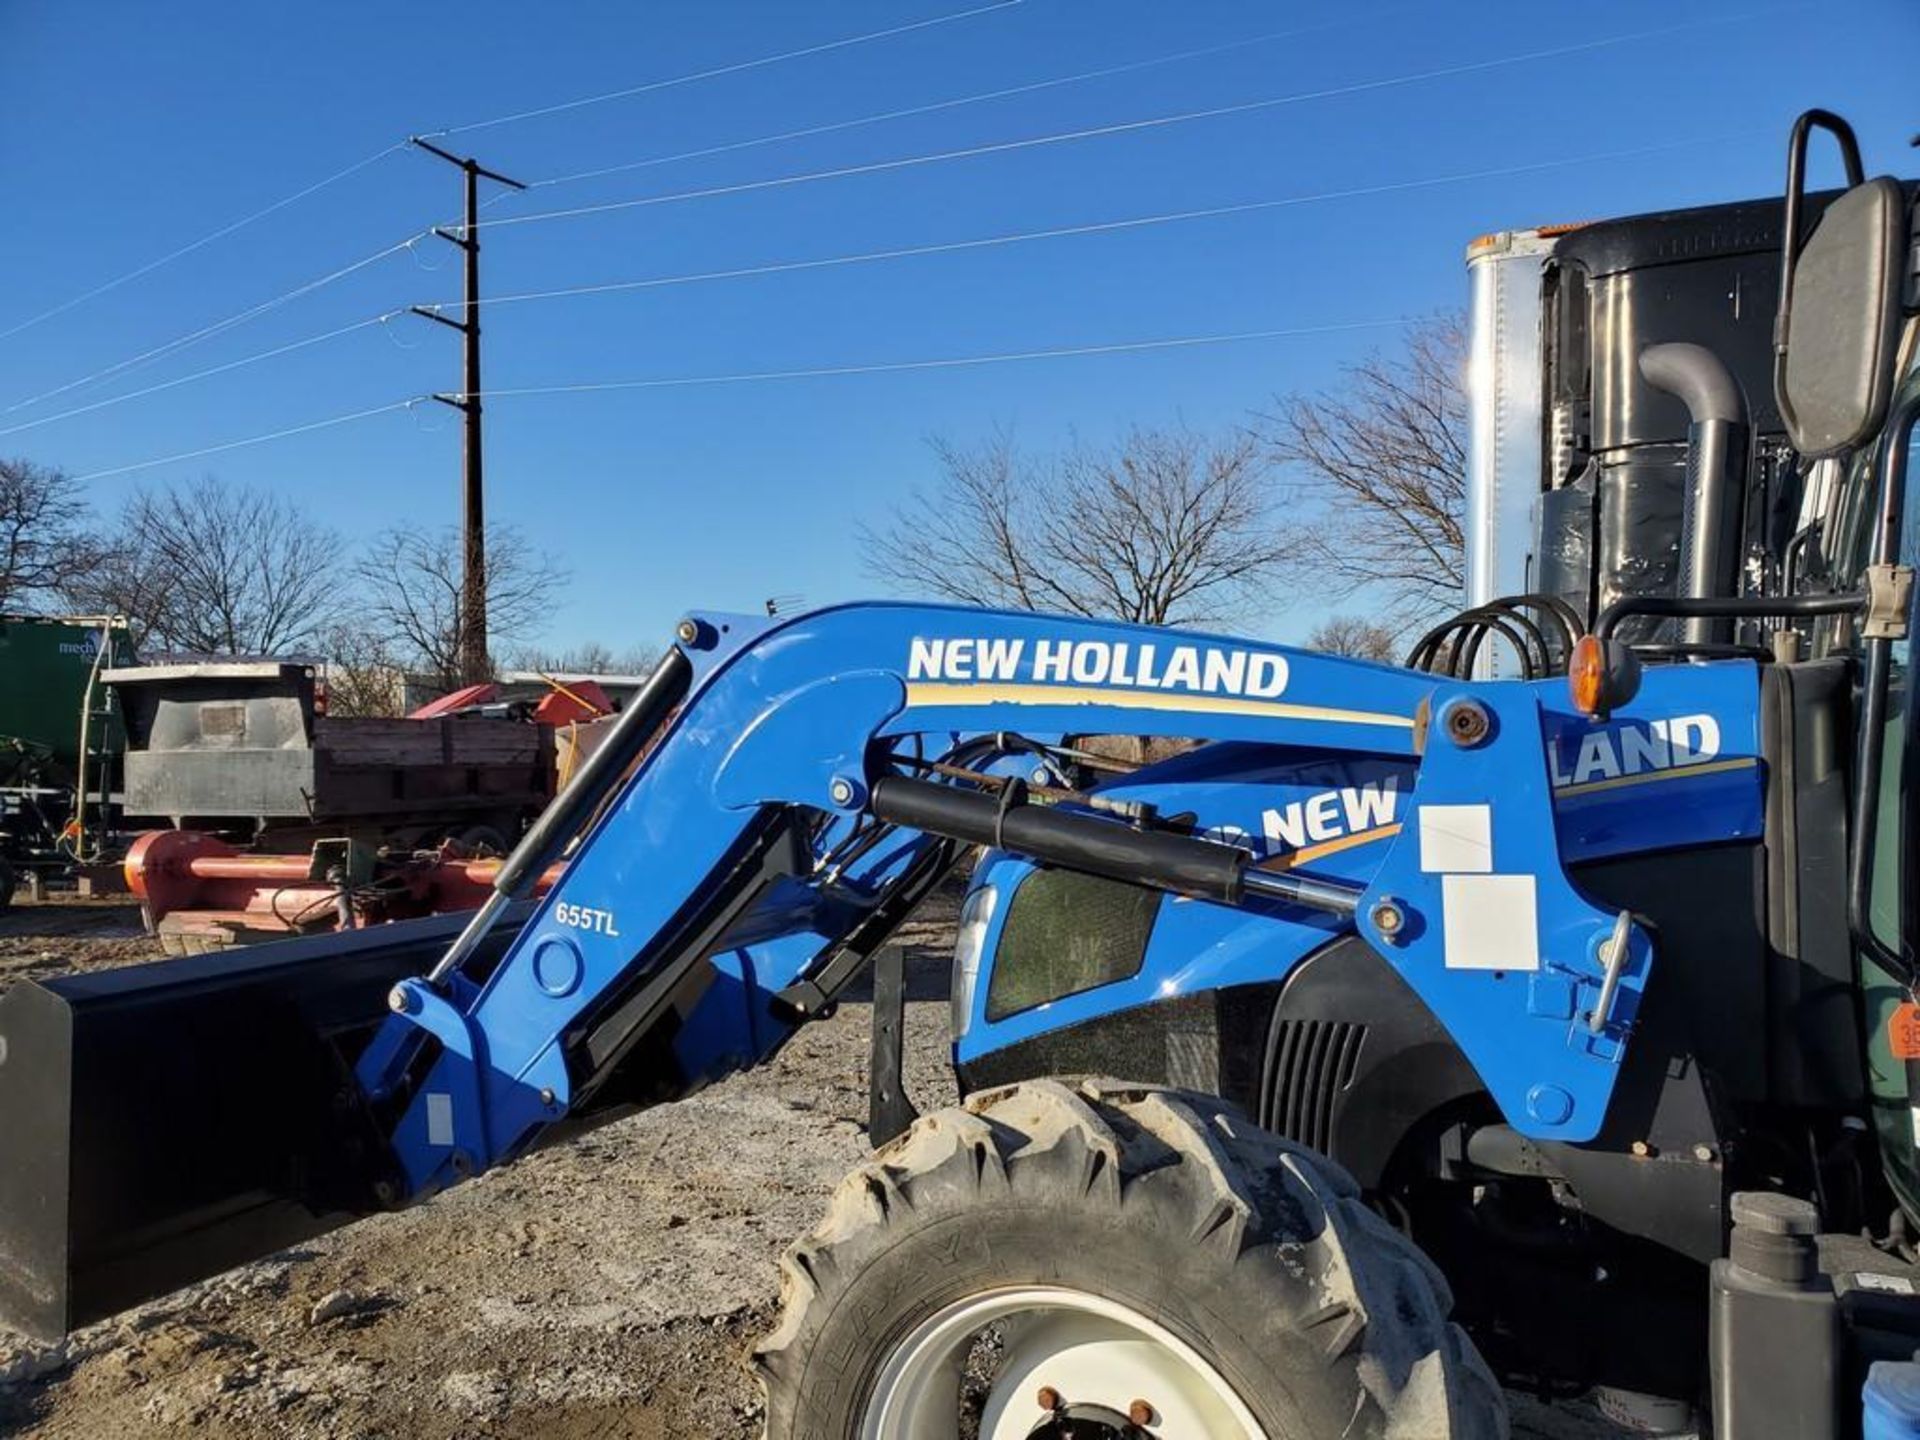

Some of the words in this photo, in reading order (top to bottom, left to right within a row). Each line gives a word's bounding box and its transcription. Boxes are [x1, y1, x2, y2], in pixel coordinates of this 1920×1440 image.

[910, 639, 1023, 679] NEW
[1033, 640, 1289, 698] HOLLAND
[1547, 713, 1721, 787] LAND
[1261, 776, 1398, 855] NEW
[556, 902, 620, 936] 655TL
